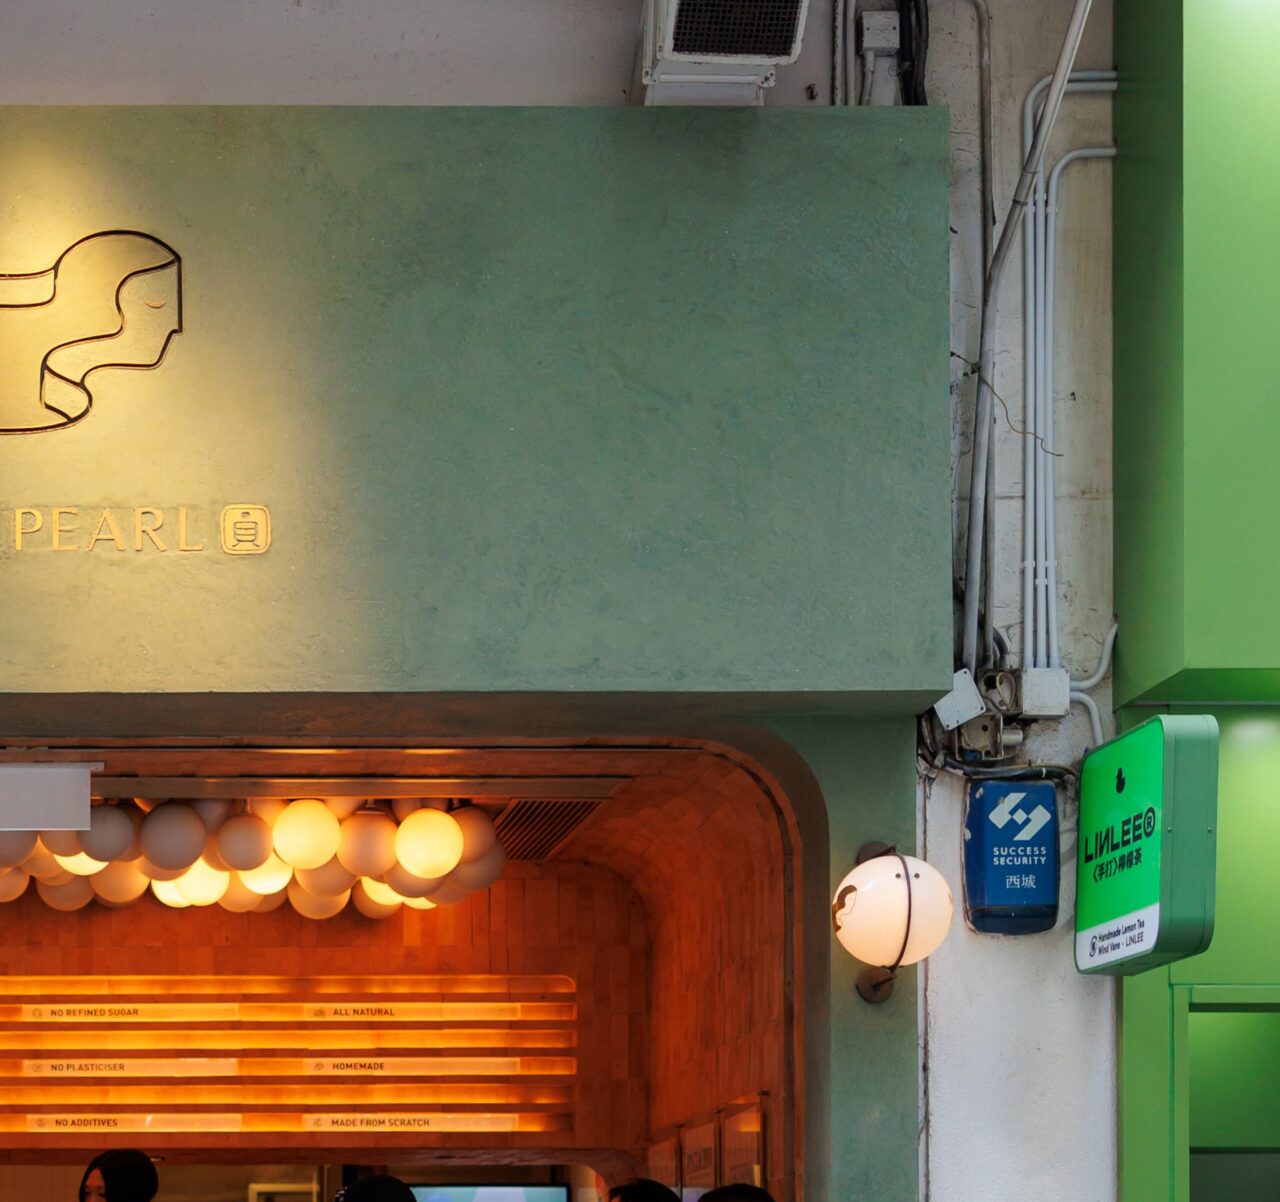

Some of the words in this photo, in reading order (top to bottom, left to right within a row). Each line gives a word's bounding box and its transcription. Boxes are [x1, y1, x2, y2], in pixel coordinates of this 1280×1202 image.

[14, 507, 204, 553] PEARL
[993, 846, 1047, 855] SUCCESS
[993, 856, 1047, 865] SECURITY
[1005, 874, 1036, 889] 西城
[50, 1009, 63, 1017] NO
[66, 1008, 105, 1017] REFINED
[108, 1008, 139, 1016] SUGAR
[333, 1008, 350, 1016] ALL
[352, 1008, 395, 1016] NATURAL
[51, 1063, 64, 1071] NO
[66, 1063, 125, 1071] PLASTICISER
[332, 1062, 385, 1070] HOMEMADE
[55, 1118, 68, 1127] NO
[70, 1118, 118, 1127] ADDITIVES
[331, 1118, 357, 1127] MADE
[360, 1118, 386, 1127] FROM
[388, 1118, 430, 1127] SCRATCH
